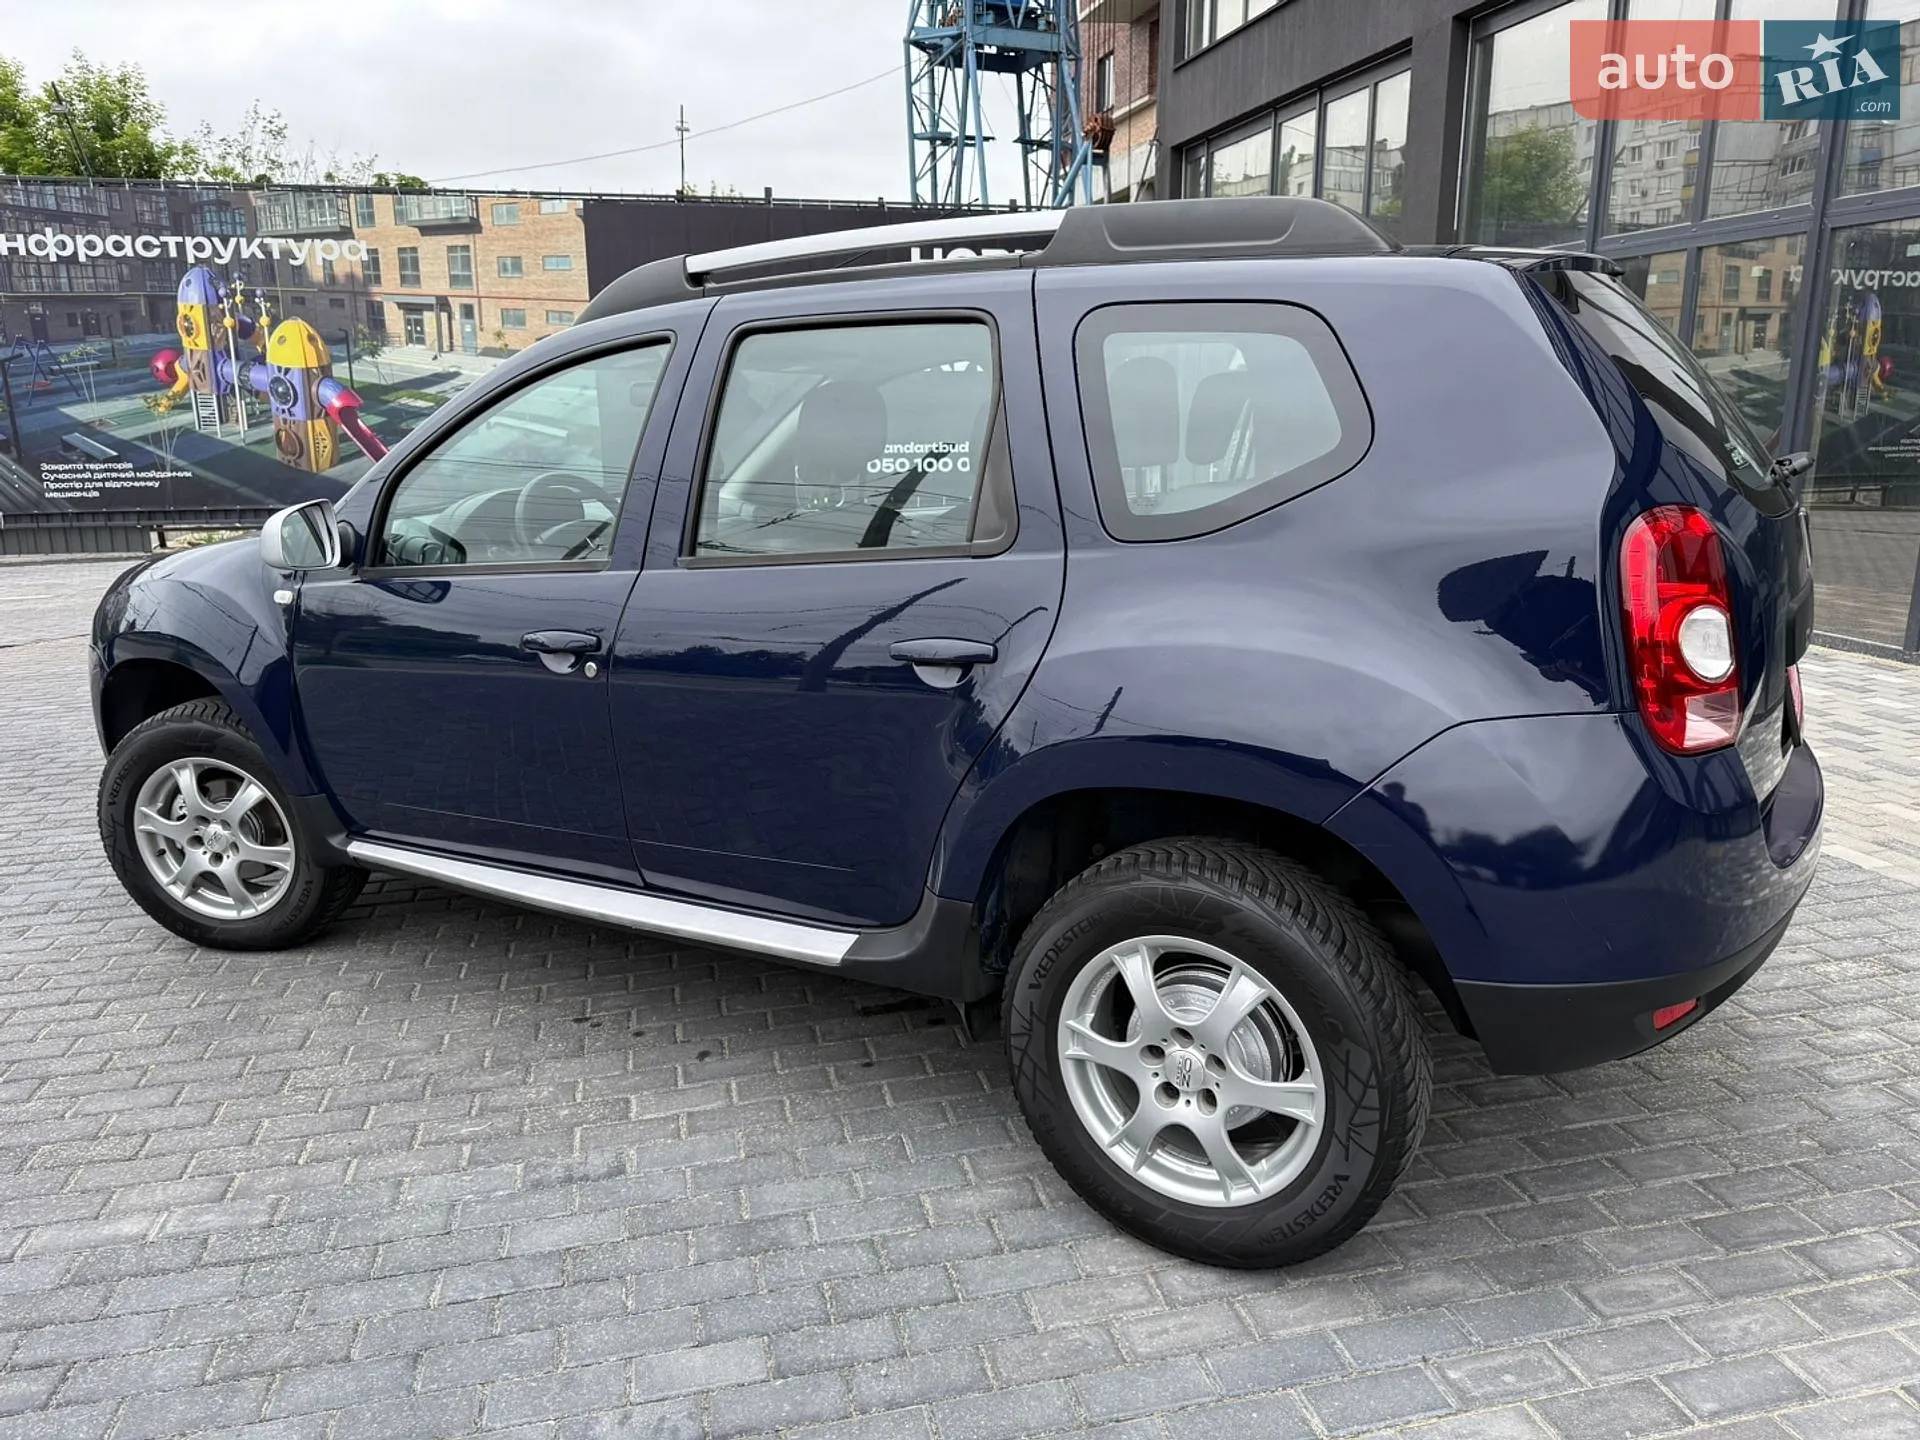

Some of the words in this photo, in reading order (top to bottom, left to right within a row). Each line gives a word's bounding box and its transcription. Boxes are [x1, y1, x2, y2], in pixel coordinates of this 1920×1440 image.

[866, 457, 910, 473] 050
[913, 457, 953, 473] 100
[84, 481, 104, 489] для
